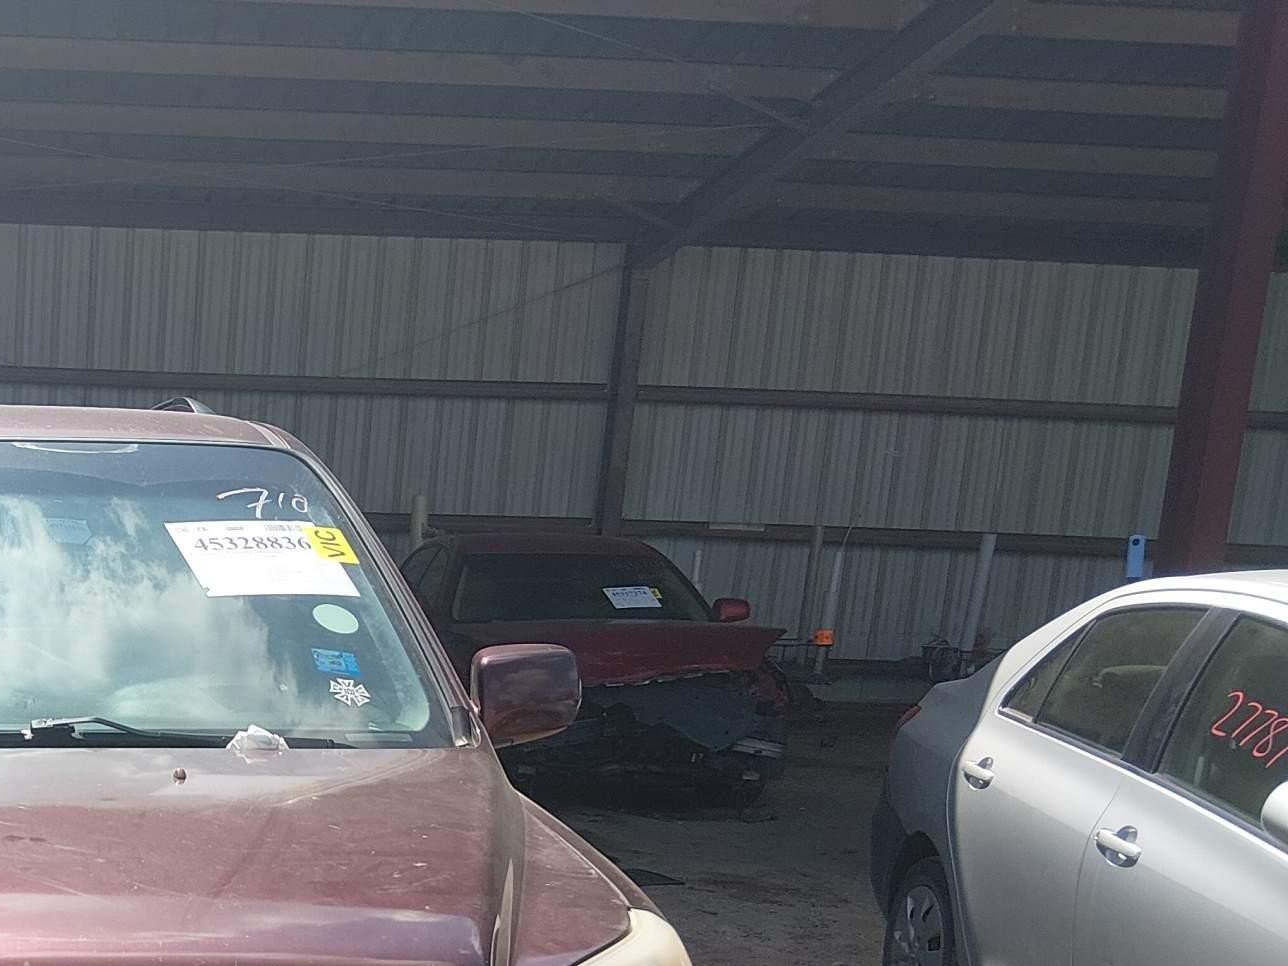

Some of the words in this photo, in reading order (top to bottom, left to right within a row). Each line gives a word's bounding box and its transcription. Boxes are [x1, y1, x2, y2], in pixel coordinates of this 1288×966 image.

[216, 487, 309, 520] 710
[194, 535, 312, 551] 45328836
[314, 530, 346, 557] VIC
